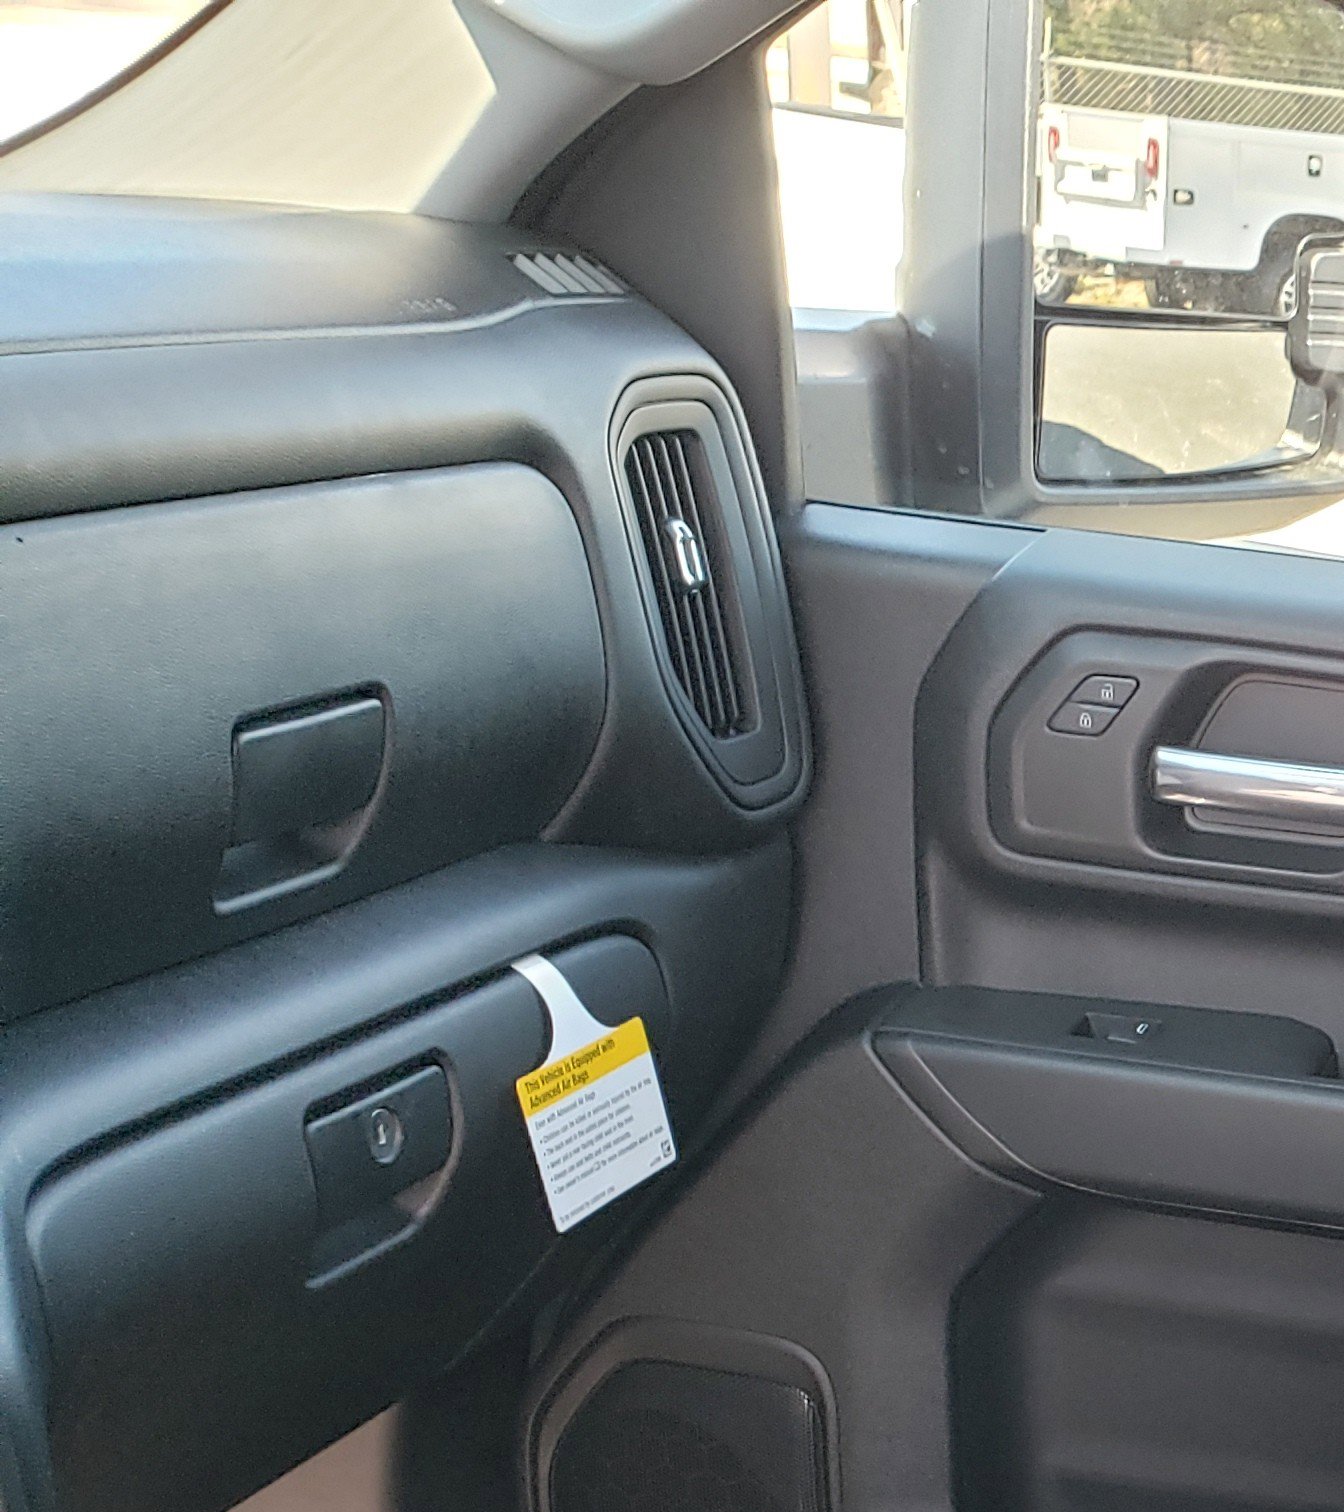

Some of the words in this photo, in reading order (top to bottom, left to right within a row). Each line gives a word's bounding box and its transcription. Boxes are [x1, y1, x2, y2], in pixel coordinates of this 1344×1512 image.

[525, 1079, 539, 1093] This
[539, 1066, 563, 1085] Vehicle
[564, 1062, 570, 1072] is
[571, 1045, 601, 1069] Equipped
[602, 1039, 615, 1051] with
[530, 1085, 561, 1107] Advanced
[562, 1078, 571, 1090] Air
[572, 1070, 589, 1086] Bags
